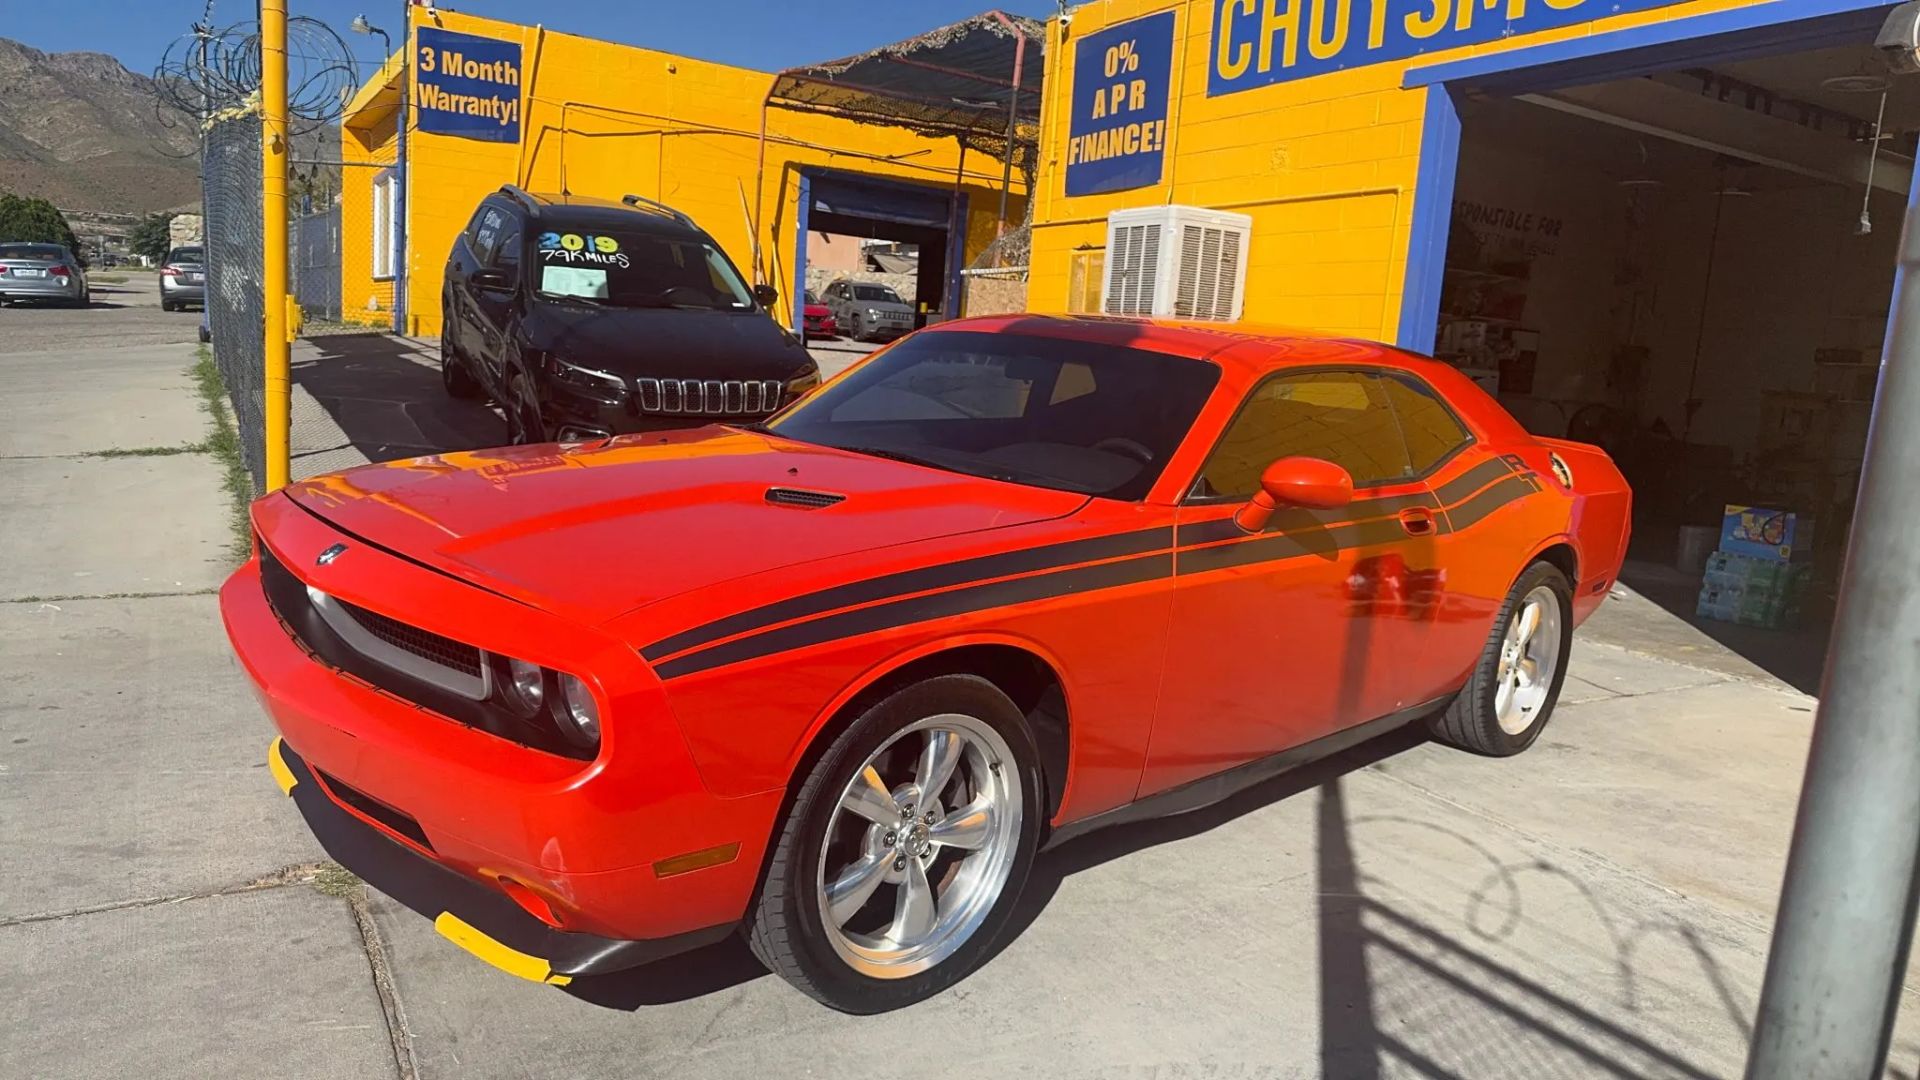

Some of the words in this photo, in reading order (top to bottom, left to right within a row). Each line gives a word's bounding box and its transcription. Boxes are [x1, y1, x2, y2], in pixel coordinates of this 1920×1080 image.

[420, 46, 436, 72] 3
[442, 50, 518, 86] Month
[1104, 39, 1139, 78] 0%
[418, 82, 518, 126] Warranty!
[1068, 119, 1165, 166] FINANCE!
[1454, 199, 1532, 232] SPONSIBLE
[1537, 216, 1563, 237] FOR
[539, 232, 619, 253] 2019
